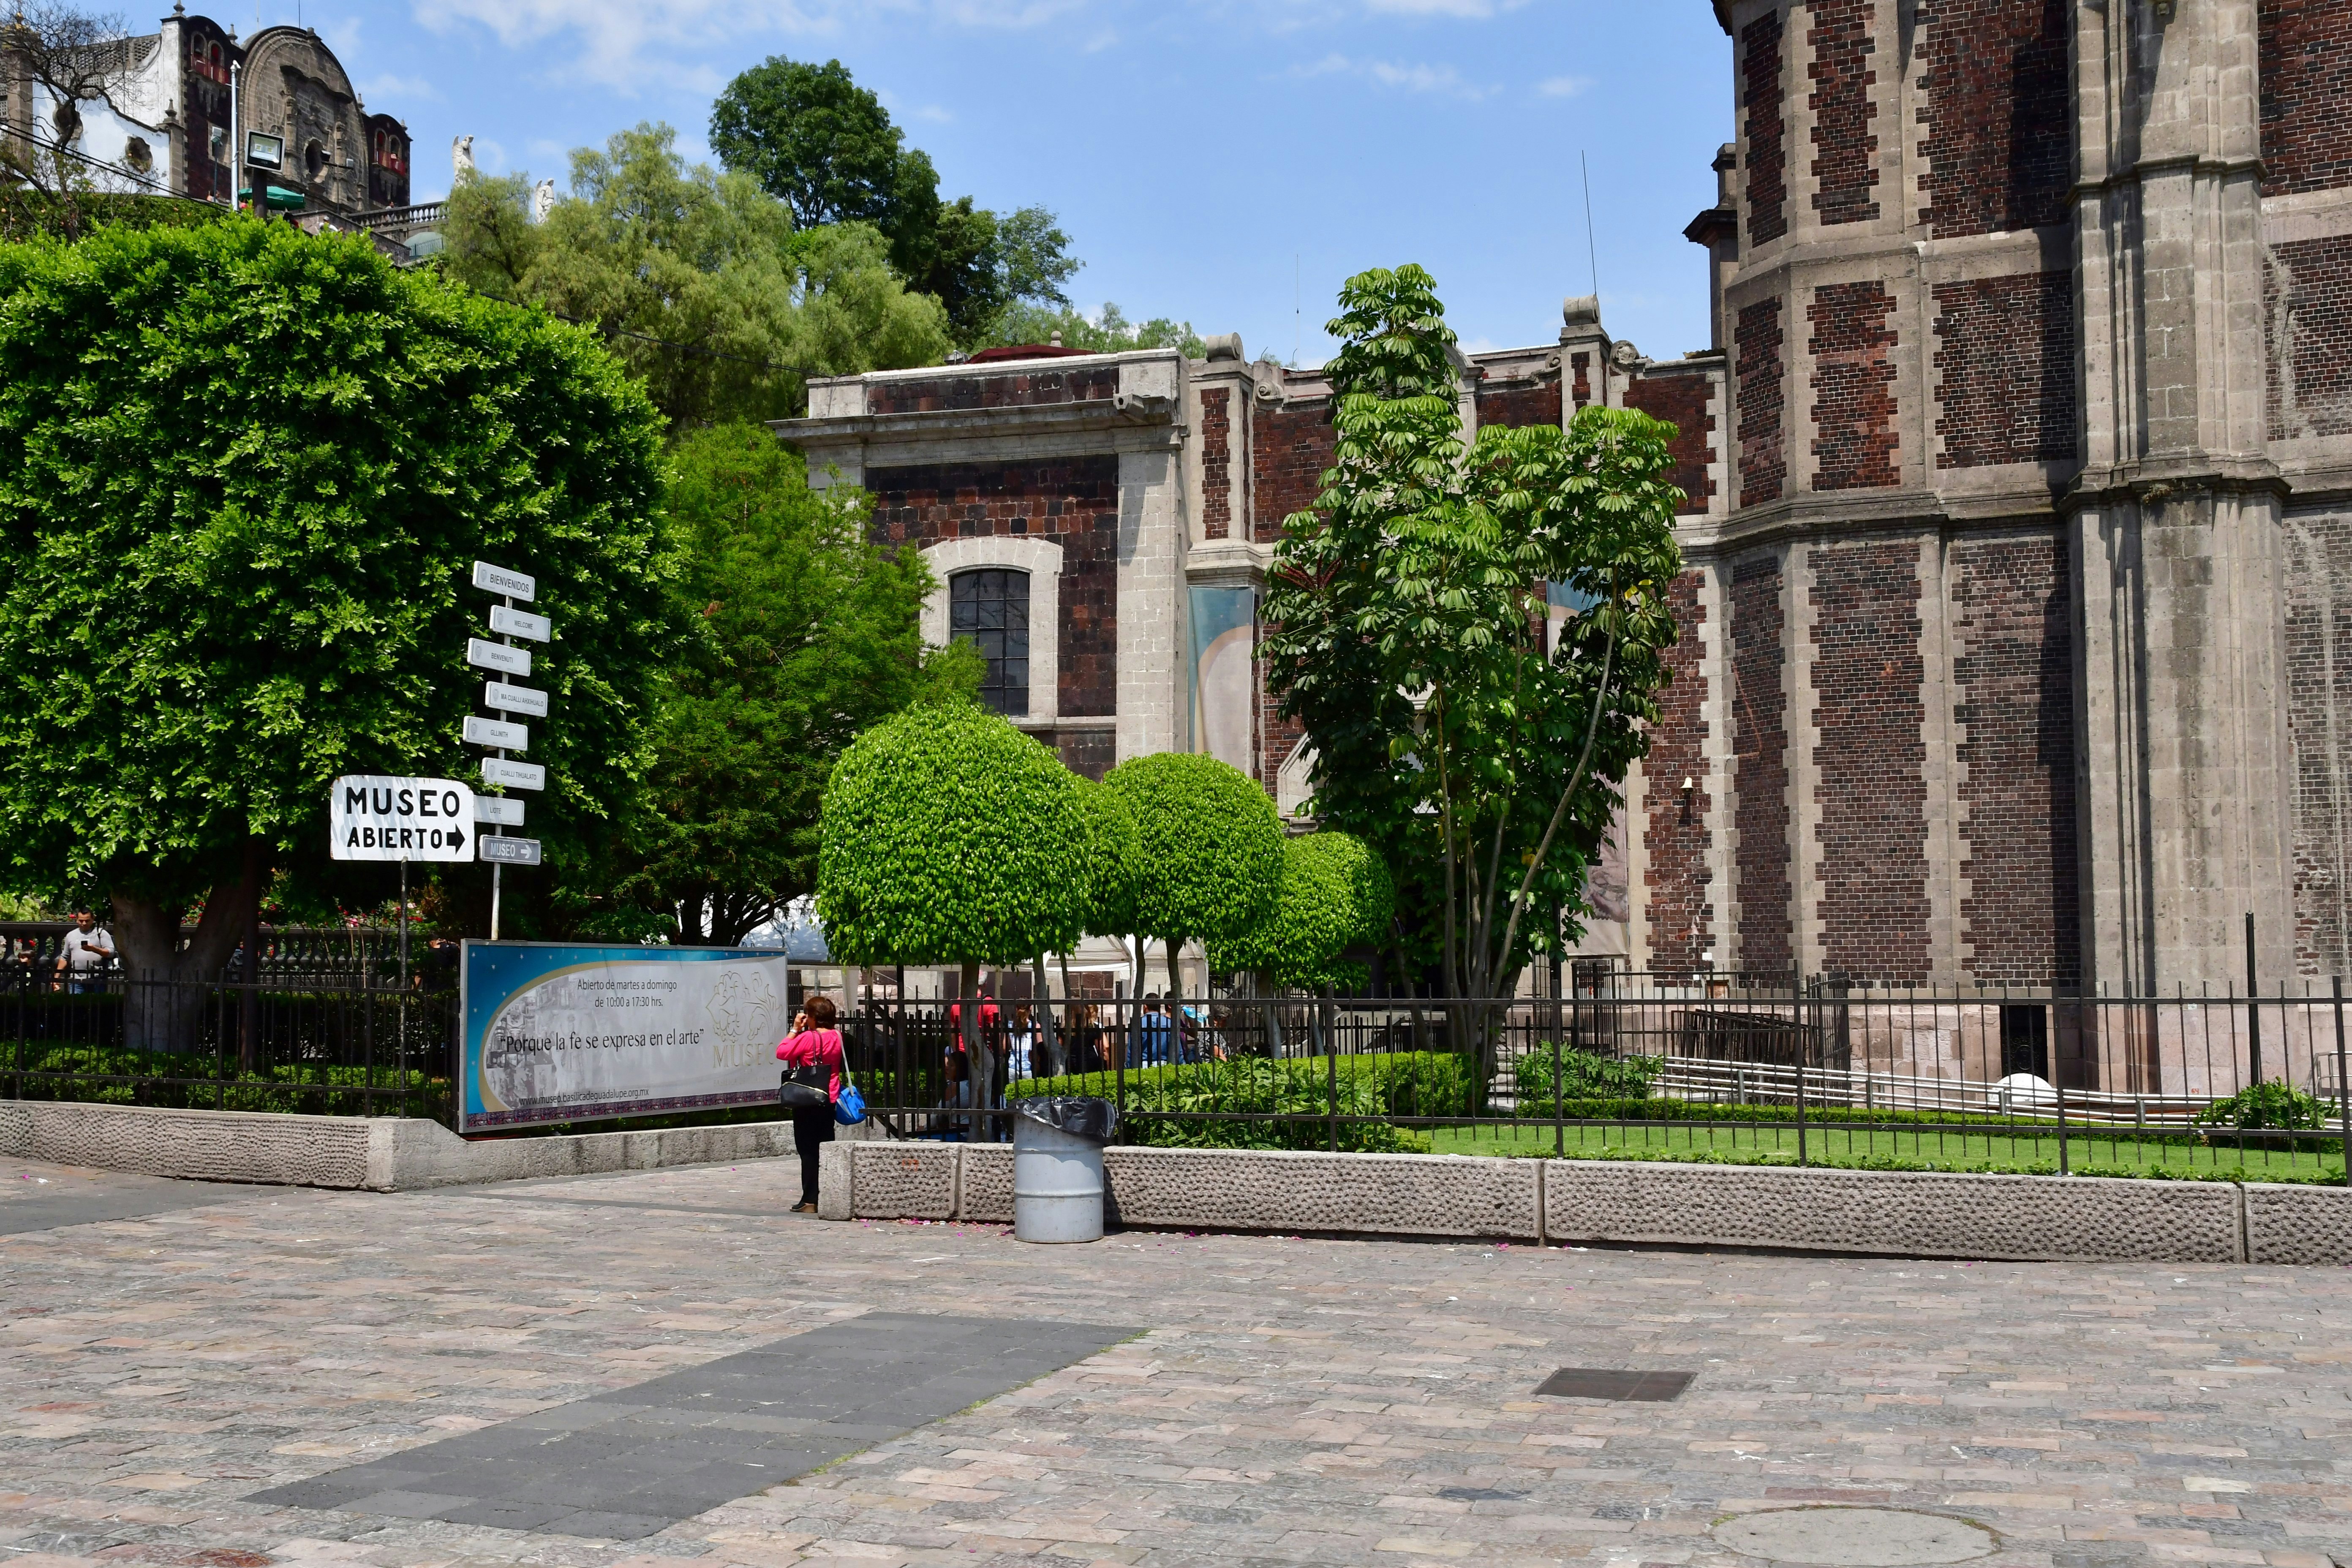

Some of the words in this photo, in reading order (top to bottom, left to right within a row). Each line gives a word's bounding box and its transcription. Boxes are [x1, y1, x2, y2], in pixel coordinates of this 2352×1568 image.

[490, 574, 529, 593] BIENVENIDOS
[514, 620, 534, 630] WELCOME
[491, 653, 513, 663] BENVENUTI
[507, 694, 522, 703] CUALLI
[346, 787, 460, 817] MUSEO
[347, 827, 442, 849] ABIERTO
[490, 842, 515, 857] MUSEO
[577, 979, 604, 990] Abierto
[606, 979, 615, 990] de
[616, 980, 640, 990] martes
[647, 979, 677, 992] domingo
[595, 997, 604, 1007] de
[607, 997, 624, 1007] 10:00
[632, 997, 650, 1007] 17:30
[651, 996, 663, 1006] hrs.
[556, 1032, 565, 1050] la
[569, 1031, 581, 1049] fe
[586, 1036, 599, 1049] se
[603, 1034, 645, 1052] expresa
[650, 1034, 663, 1046] en
[667, 1029, 675, 1045] el
[679, 1029, 704, 1045] arte”
[713, 1043, 776, 1068] MUSEO
[519, 1088, 649, 1105] www.museo.basilicadeguadalupe.org.mx
